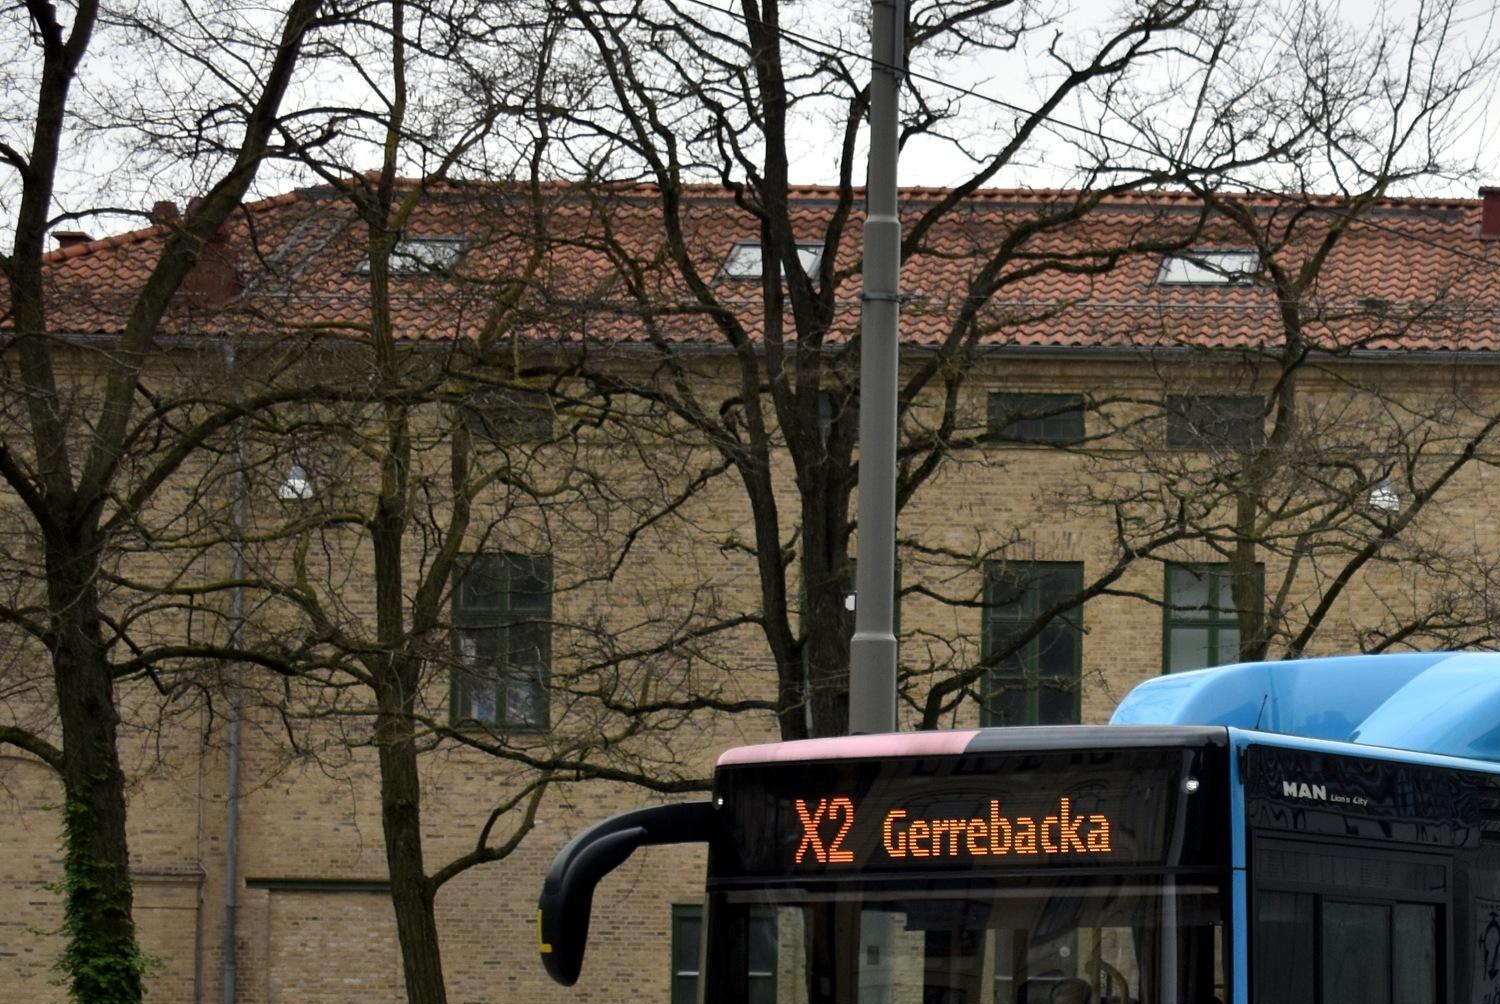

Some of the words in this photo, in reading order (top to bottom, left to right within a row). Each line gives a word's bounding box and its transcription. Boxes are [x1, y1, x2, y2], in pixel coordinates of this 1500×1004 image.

[1283, 781, 1327, 801] MAN
[795, 798, 854, 863] X2
[883, 798, 1112, 858] Gerrebacka
